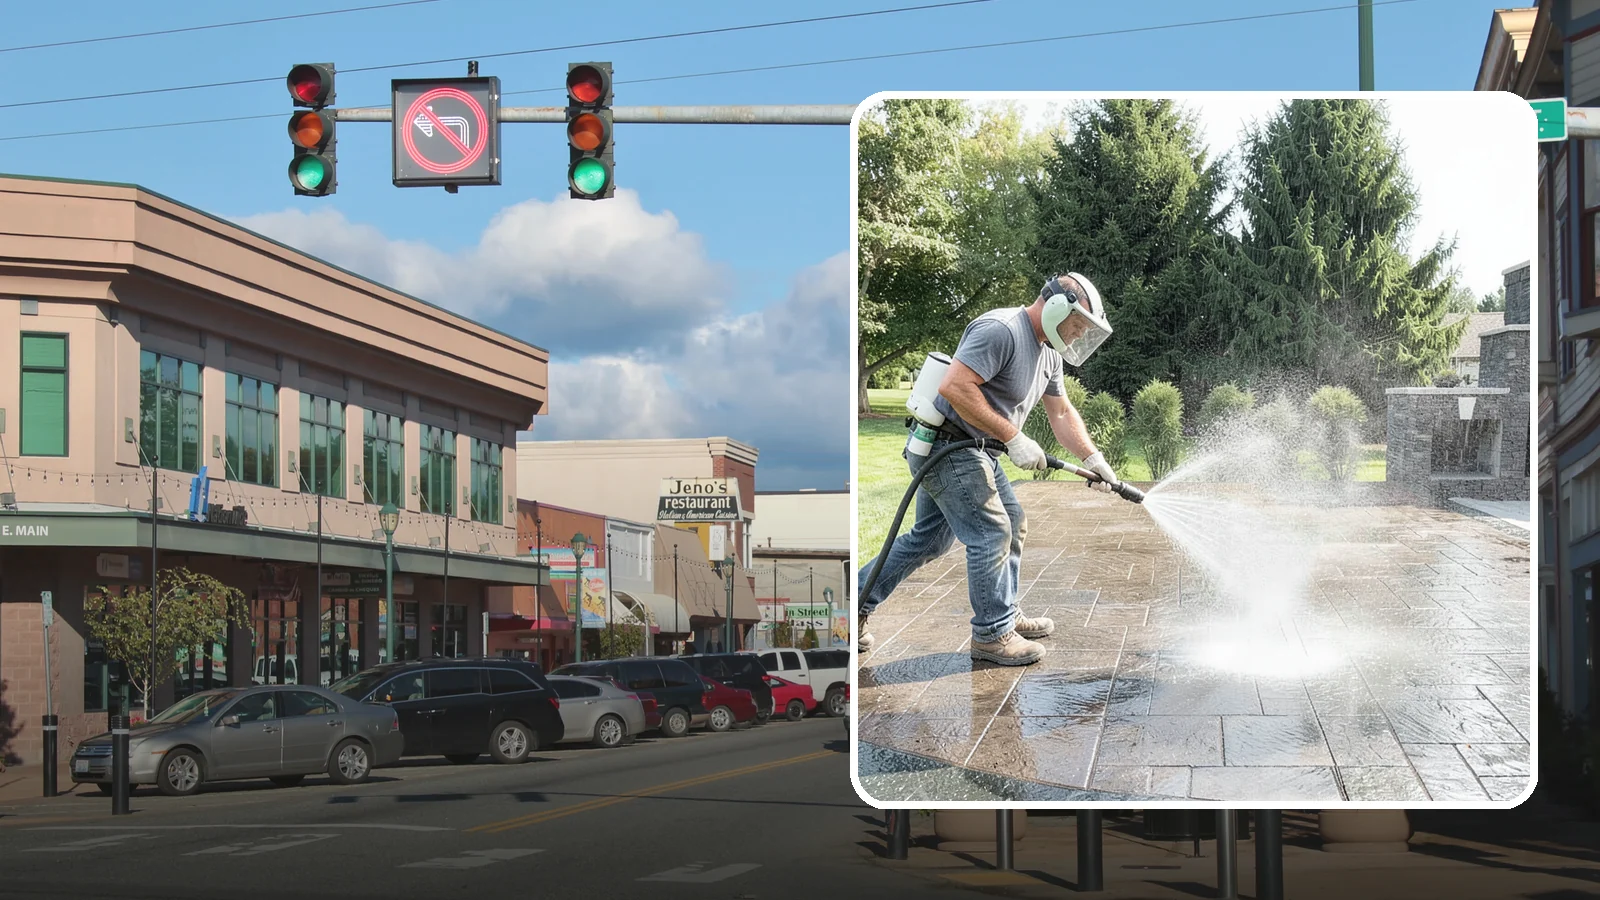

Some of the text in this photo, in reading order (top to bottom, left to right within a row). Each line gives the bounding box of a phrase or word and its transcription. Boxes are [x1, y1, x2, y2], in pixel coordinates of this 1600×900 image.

[669, 480, 727, 495] Jeno's
[665, 496, 731, 509] restaurant
[658, 509, 681, 520] Italian
[686, 509, 714, 519] American
[714, 509, 738, 519] Cuisine
[2, 525, 49, 536] E. MAIN
[797, 607, 828, 616] Street
